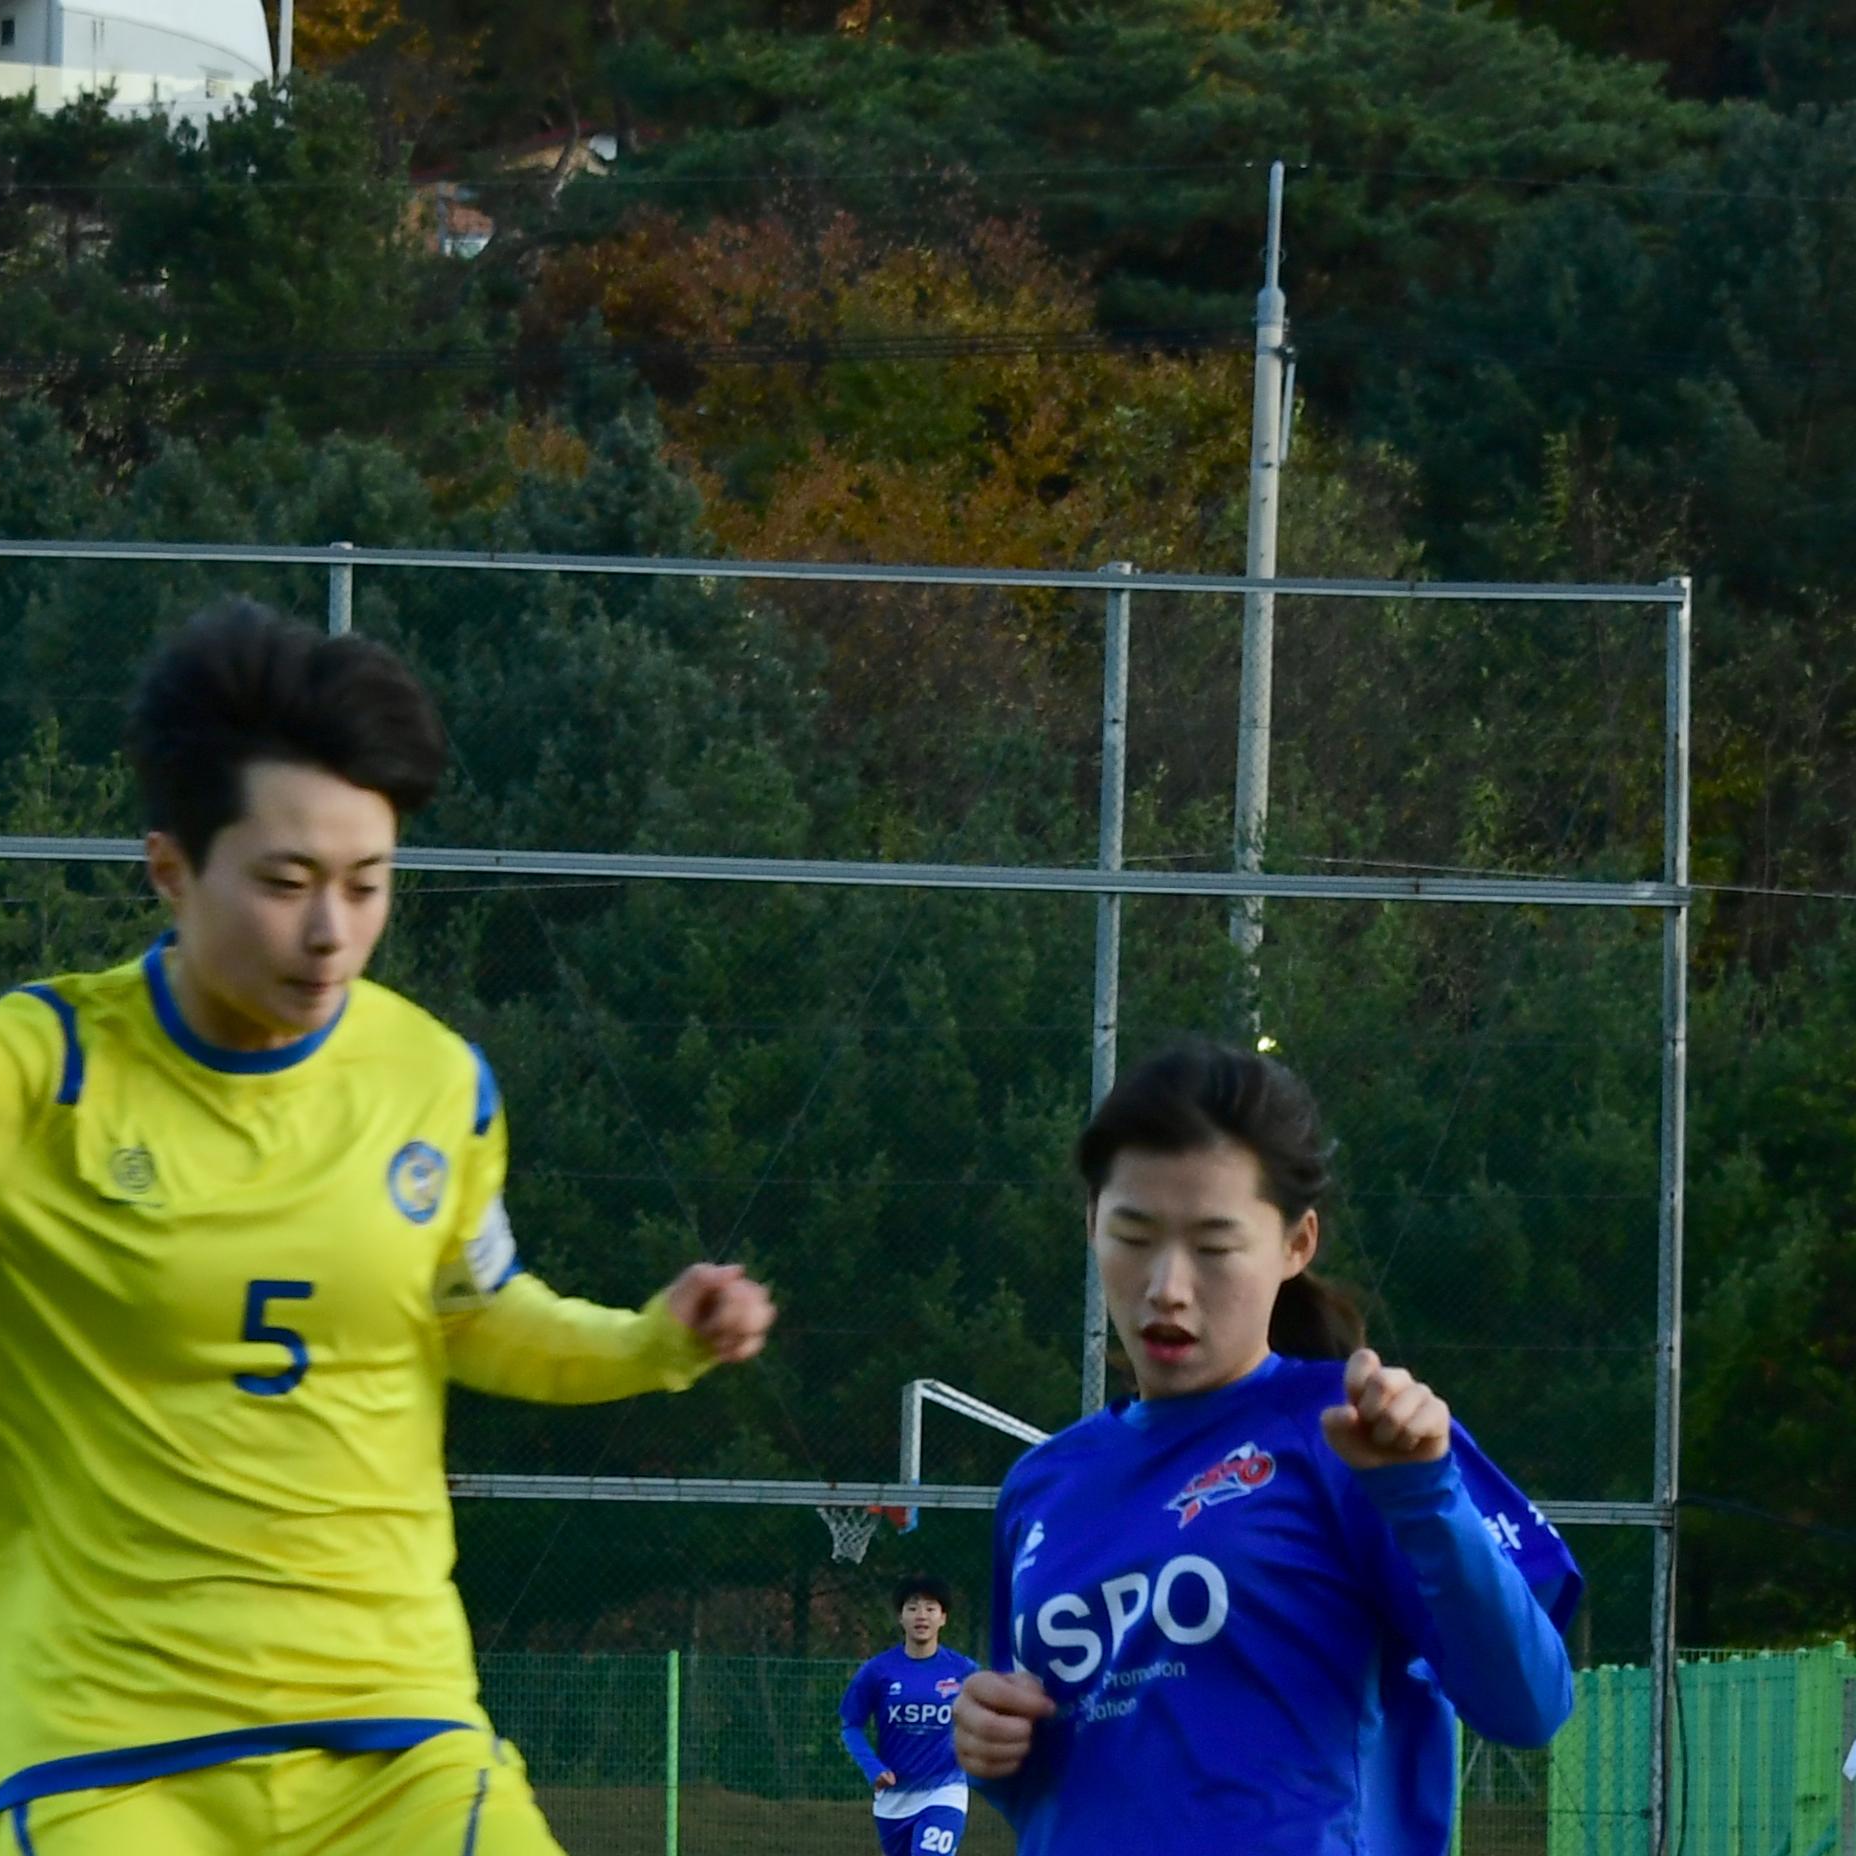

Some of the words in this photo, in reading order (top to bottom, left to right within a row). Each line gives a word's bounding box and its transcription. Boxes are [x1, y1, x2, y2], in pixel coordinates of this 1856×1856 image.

[232, 1278, 314, 1398] 5
[1013, 1553, 1230, 1683] SPO
[887, 1704, 953, 1725] KSPO
[920, 1826, 955, 1855] 20
